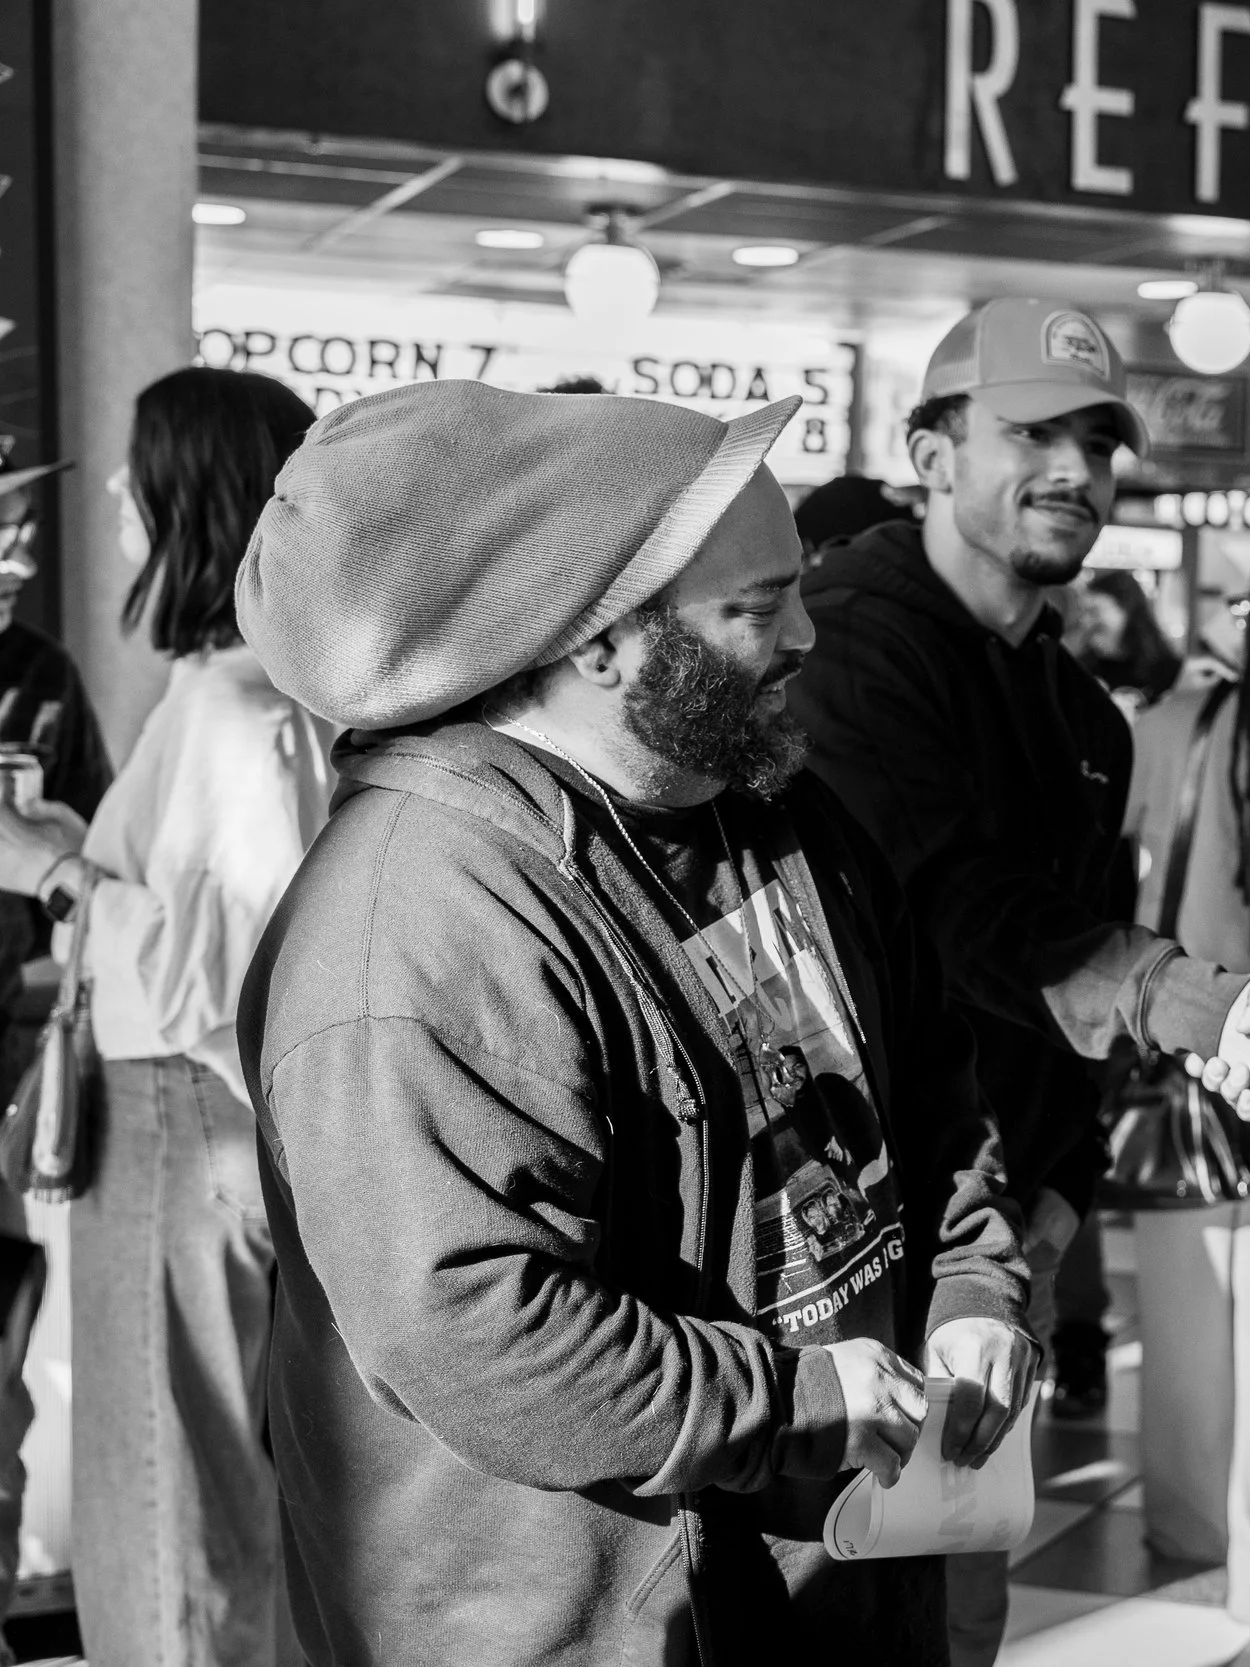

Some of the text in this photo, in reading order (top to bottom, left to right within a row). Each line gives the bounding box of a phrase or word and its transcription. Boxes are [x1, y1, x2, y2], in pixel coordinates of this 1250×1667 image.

[200, 329, 496, 380] OPCORN 7
[632, 356, 829, 404] SODA 5
[802, 417, 827, 452] 8
[849, 1256, 882, 1296] WAS
